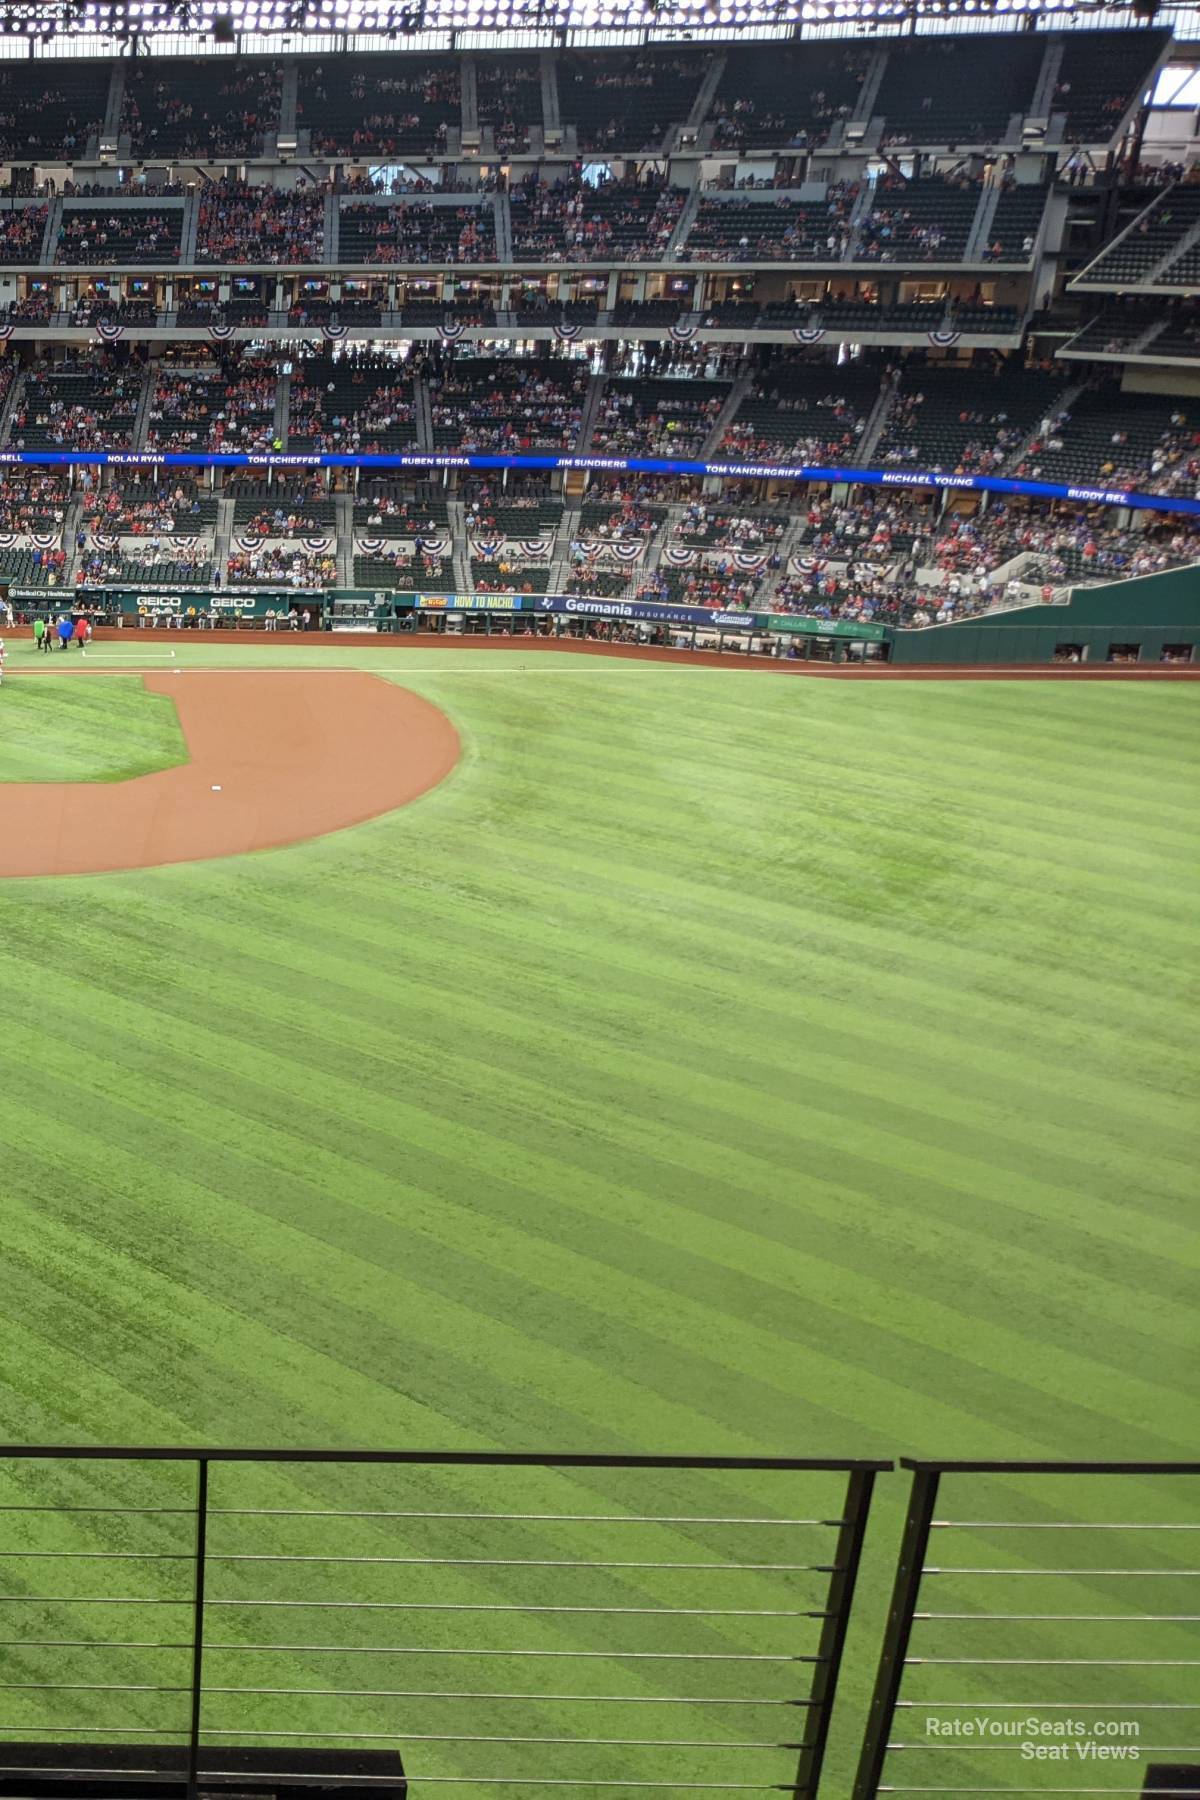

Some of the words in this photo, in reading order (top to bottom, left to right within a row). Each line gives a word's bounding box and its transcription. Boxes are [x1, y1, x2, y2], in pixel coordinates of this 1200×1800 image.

[107, 455, 138, 463] NOLAN
[140, 455, 165, 463] RYAN
[248, 456, 268, 464] TOM
[269, 456, 321, 464] SCHIEFFER
[401, 457, 434, 465] RUBEN
[436, 457, 470, 465] SIERRA
[556, 458, 573, 467] JIM
[574, 458, 628, 468] SUNDBERG
[705, 464, 728, 474] TOM
[728, 466, 802, 477] VANDERGRIFF
[881, 473, 933, 485] MICHAEL
[934, 477, 974, 487] YOUNG
[1066, 488, 1104, 501] BUDDY
[37, 590, 47, 598] City
[136, 596, 182, 606] GEICO
[210, 598, 256, 608] GEICO
[454, 595, 474, 608] HOW
[475, 596, 486, 608] TO
[565, 599, 633, 616] Germania
[634, 610, 693, 621] INSURANCE
